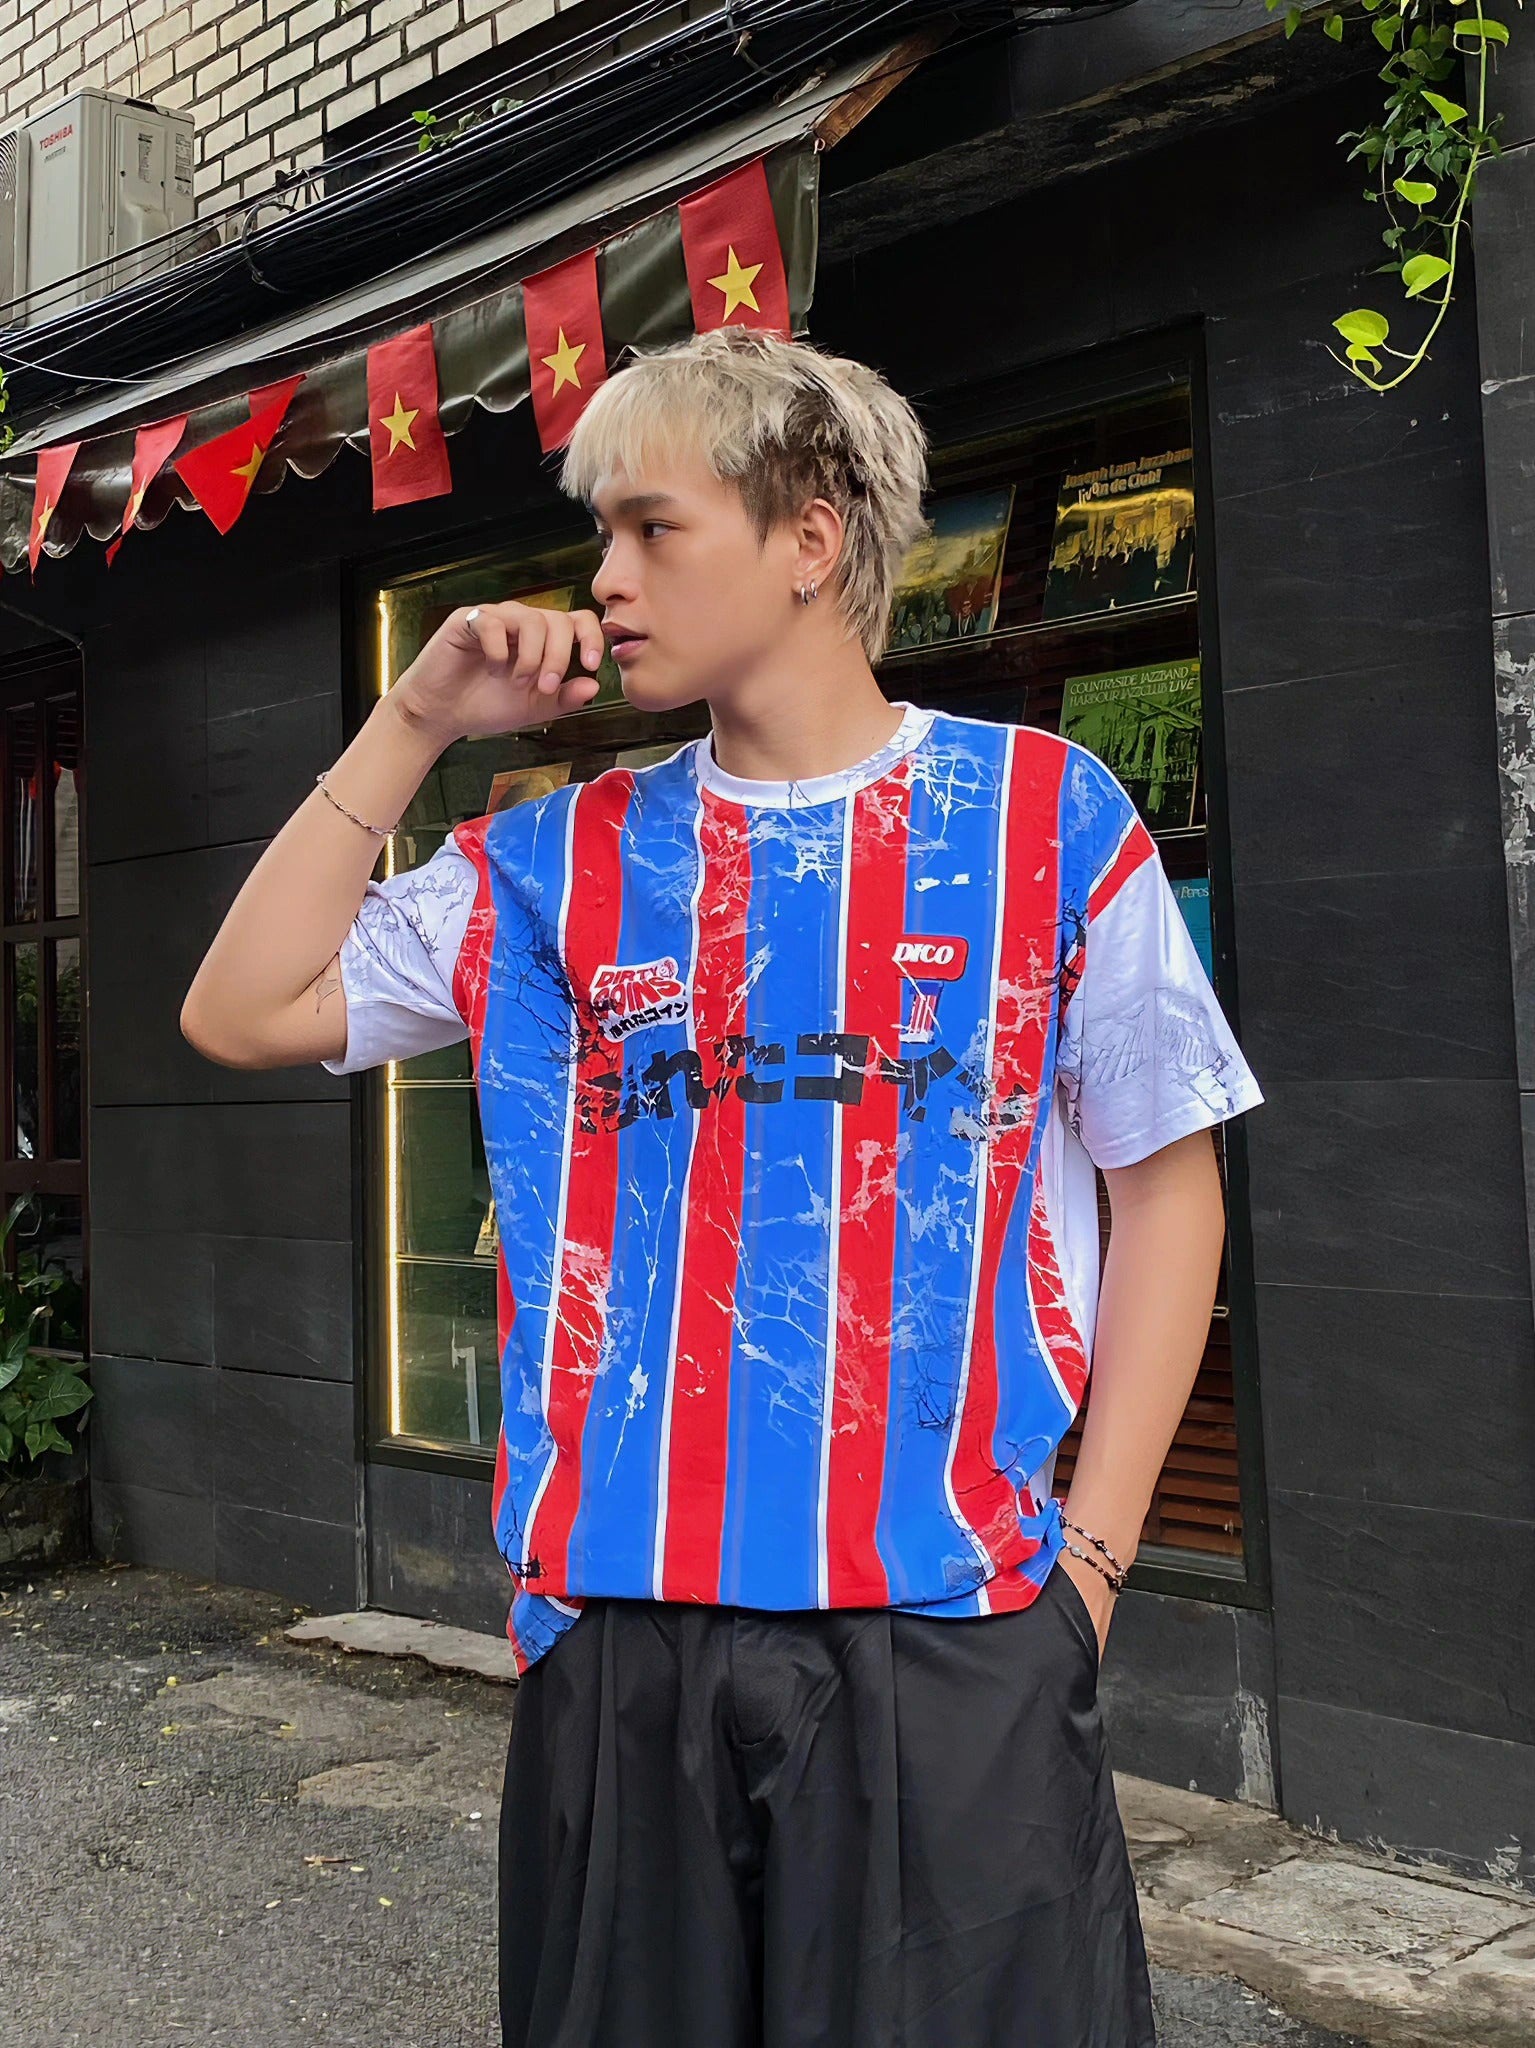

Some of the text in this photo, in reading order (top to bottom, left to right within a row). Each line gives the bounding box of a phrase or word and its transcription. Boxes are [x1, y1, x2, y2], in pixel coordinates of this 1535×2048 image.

[40, 124, 72, 150] TOSHIBA
[1063, 448, 1193, 489] Joseph Lam Jazzban
[1110, 478, 1127, 494] de
[1128, 468, 1162, 489] Club!
[1140, 666, 1189, 683] JAZZBAND
[1169, 677, 1198, 692] LIVE
[892, 943, 955, 964] DICO
[595, 966, 658, 988] DIRTY
[593, 977, 682, 1020] COINS
